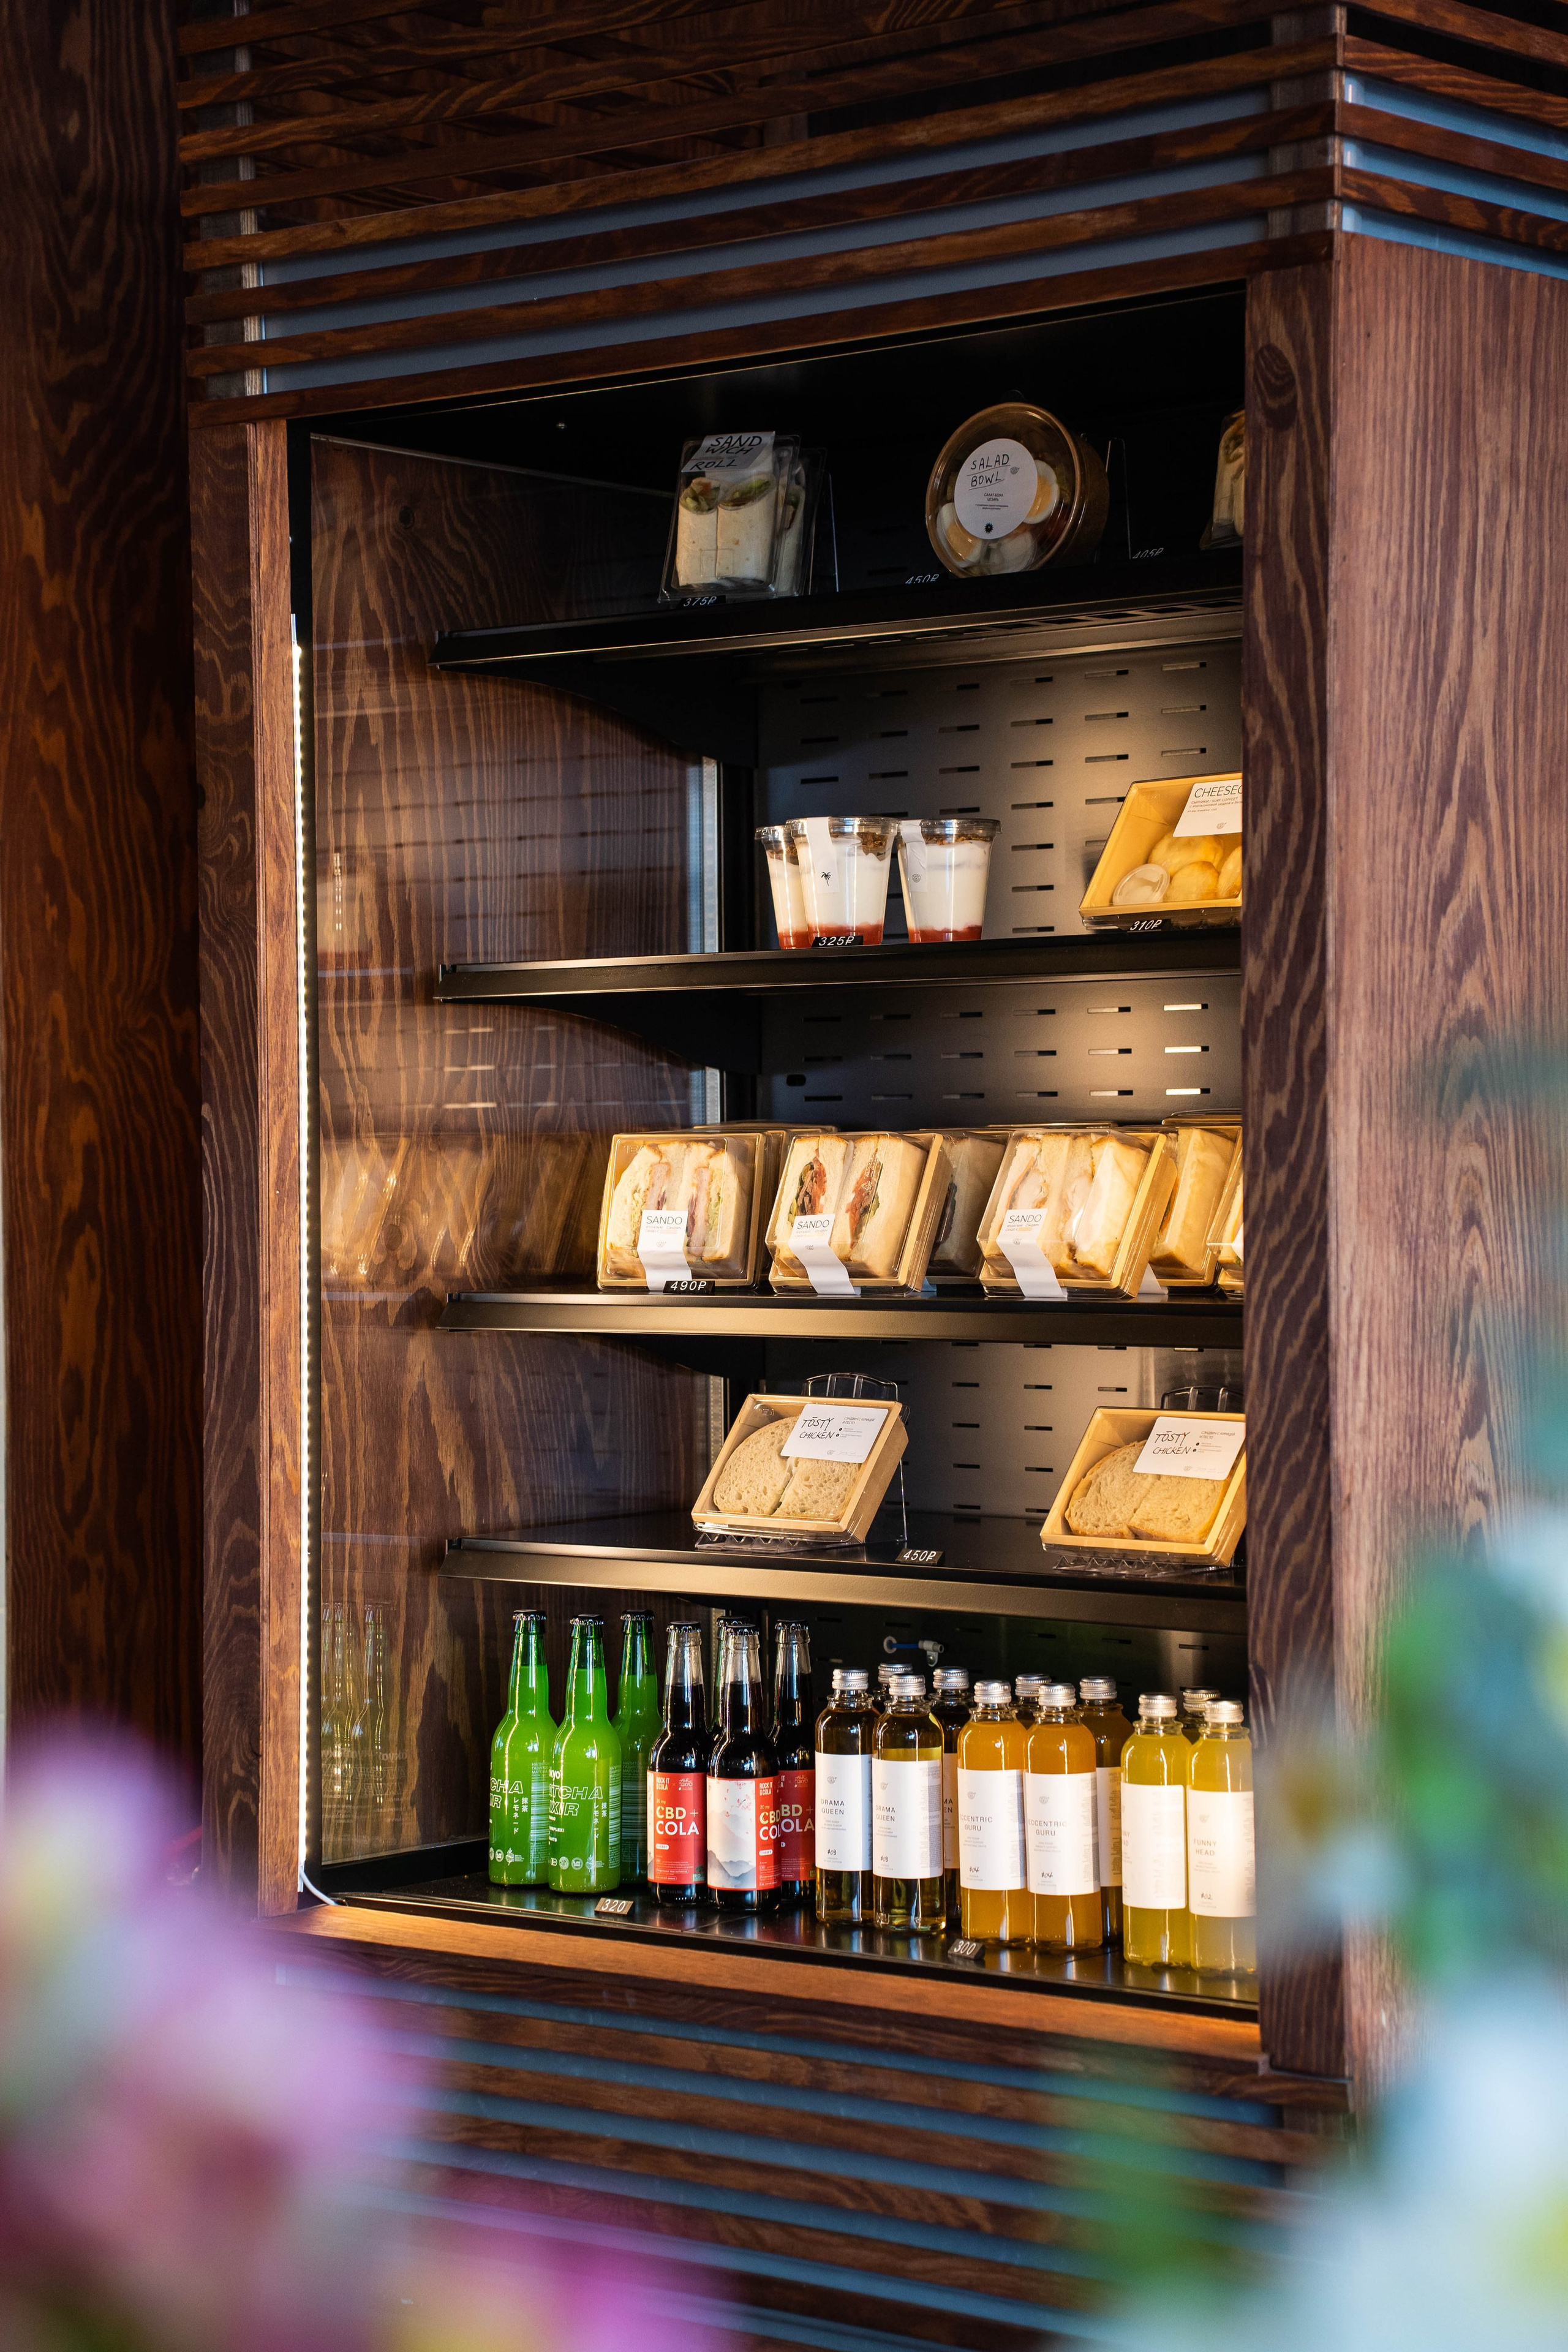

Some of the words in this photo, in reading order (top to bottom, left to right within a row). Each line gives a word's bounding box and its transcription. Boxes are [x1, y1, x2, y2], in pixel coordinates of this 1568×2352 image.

[710, 434, 763, 447] SAND
[705, 446, 754, 455] WICH
[690, 459, 737, 470] ROLL
[970, 454, 1009, 470] SALAD
[971, 470, 1001, 487] BOWL
[646, 1216, 682, 1225] SANDO
[797, 1219, 830, 1229] SANDO
[1008, 1215, 1042, 1224] SANDO
[1153, 1446, 1191, 1455] CHICKEN
[522, 1796, 529, 1812] 抹茶
[875, 1804, 895, 1813] DRAMA
[656, 1806, 687, 1820] CBD
[760, 1809, 780, 1825] CBD
[960, 1814, 993, 1823] ECCENTRIC
[655, 1820, 699, 1835] COLA
[1028, 1819, 1067, 1828] ECCENTRIC
[1194, 1839, 1217, 1847] FUNNY
[601, 1899, 626, 1912] 320
[954, 1940, 976, 1955] 300
